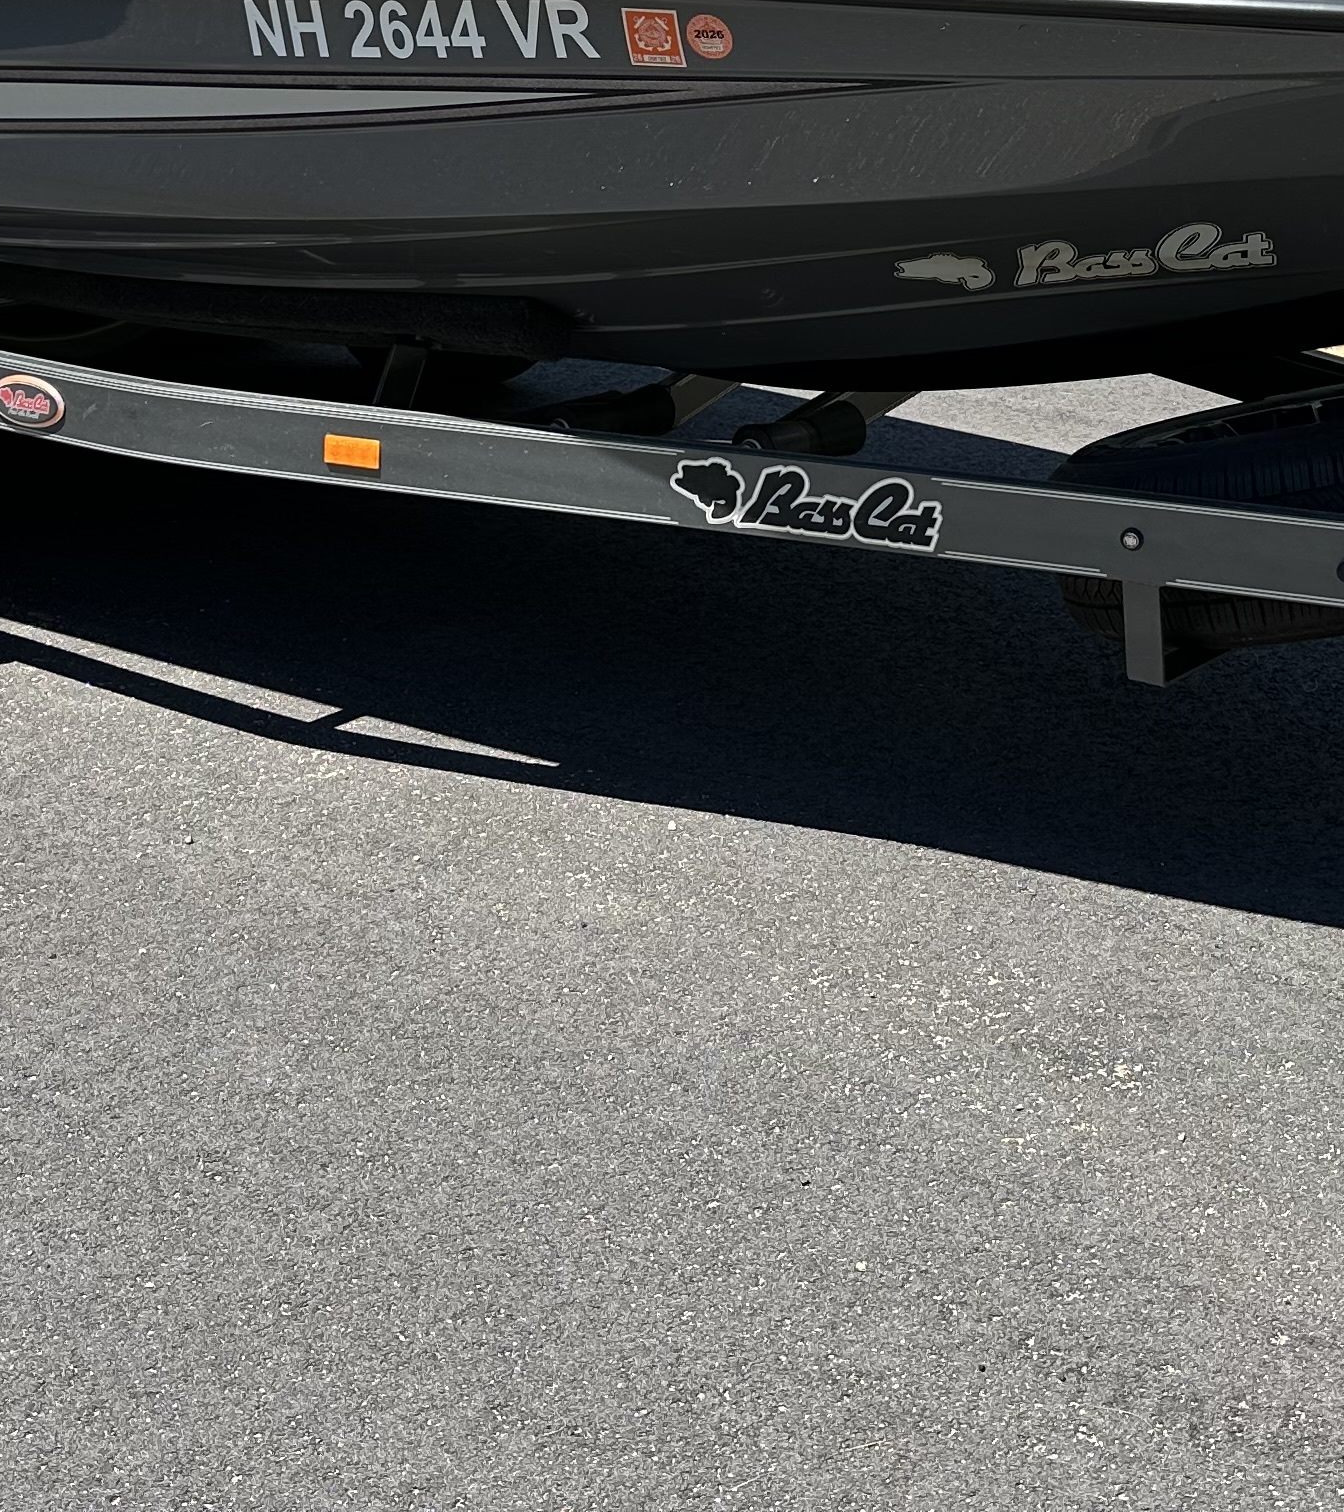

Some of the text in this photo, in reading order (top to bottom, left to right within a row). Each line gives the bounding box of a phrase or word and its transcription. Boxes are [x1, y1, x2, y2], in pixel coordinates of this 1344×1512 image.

[243, 0, 602, 60] NH 2644 VR
[693, 29, 725, 40] 2026
[1013, 221, 1278, 288] Bass Cat
[734, 464, 944, 553] Bass Cat
